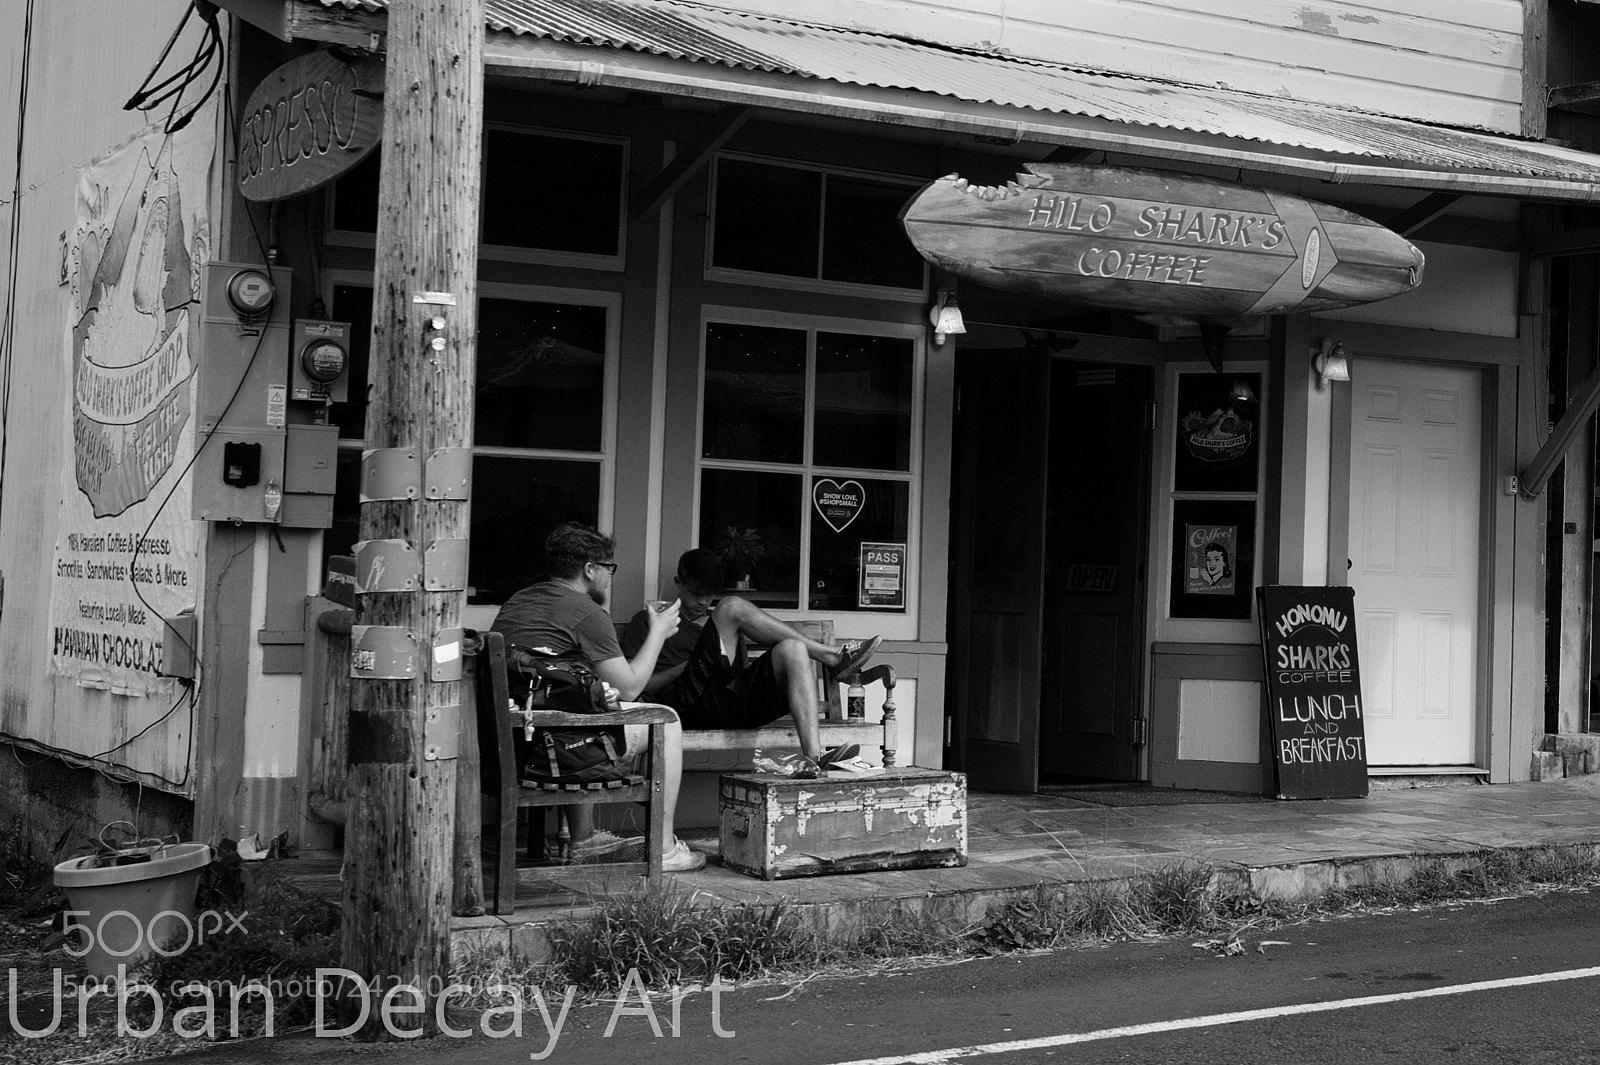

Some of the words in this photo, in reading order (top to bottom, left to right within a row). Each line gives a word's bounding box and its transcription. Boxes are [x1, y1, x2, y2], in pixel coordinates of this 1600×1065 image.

[242, 69, 359, 185] ESPRESSO
[1027, 192, 1117, 233] HILO
[1134, 205, 1287, 250] SHARK'S
[1077, 246, 1213, 286] COFFEE
[123, 362, 155, 416] COFFEE
[155, 331, 183, 398] SHOP
[819, 498, 858, 507] #SHOPSMALL
[823, 492, 841, 500] SHOW
[107, 532, 127, 553] Coffee
[128, 532, 134, 554] &
[136, 532, 171, 559] Espresso
[1189, 527, 1233, 548] Coffee!
[867, 551, 899, 563] PASS
[87, 559, 125, 581] Sandwiches
[130, 562, 153, 584] Salads
[156, 563, 162, 585] &
[164, 562, 188, 587] More
[1070, 565, 1114, 590] OPEN
[105, 601, 126, 628] Locally
[128, 604, 147, 626] Made
[1275, 603, 1348, 638] HONOMU
[1277, 641, 1350, 671] SHARK'S
[1278, 671, 1353, 684] COFFEE
[1278, 694, 1361, 722] LUNCH
[1303, 722, 1339, 735] AND
[1280, 736, 1364, 764] BREAKFAST
